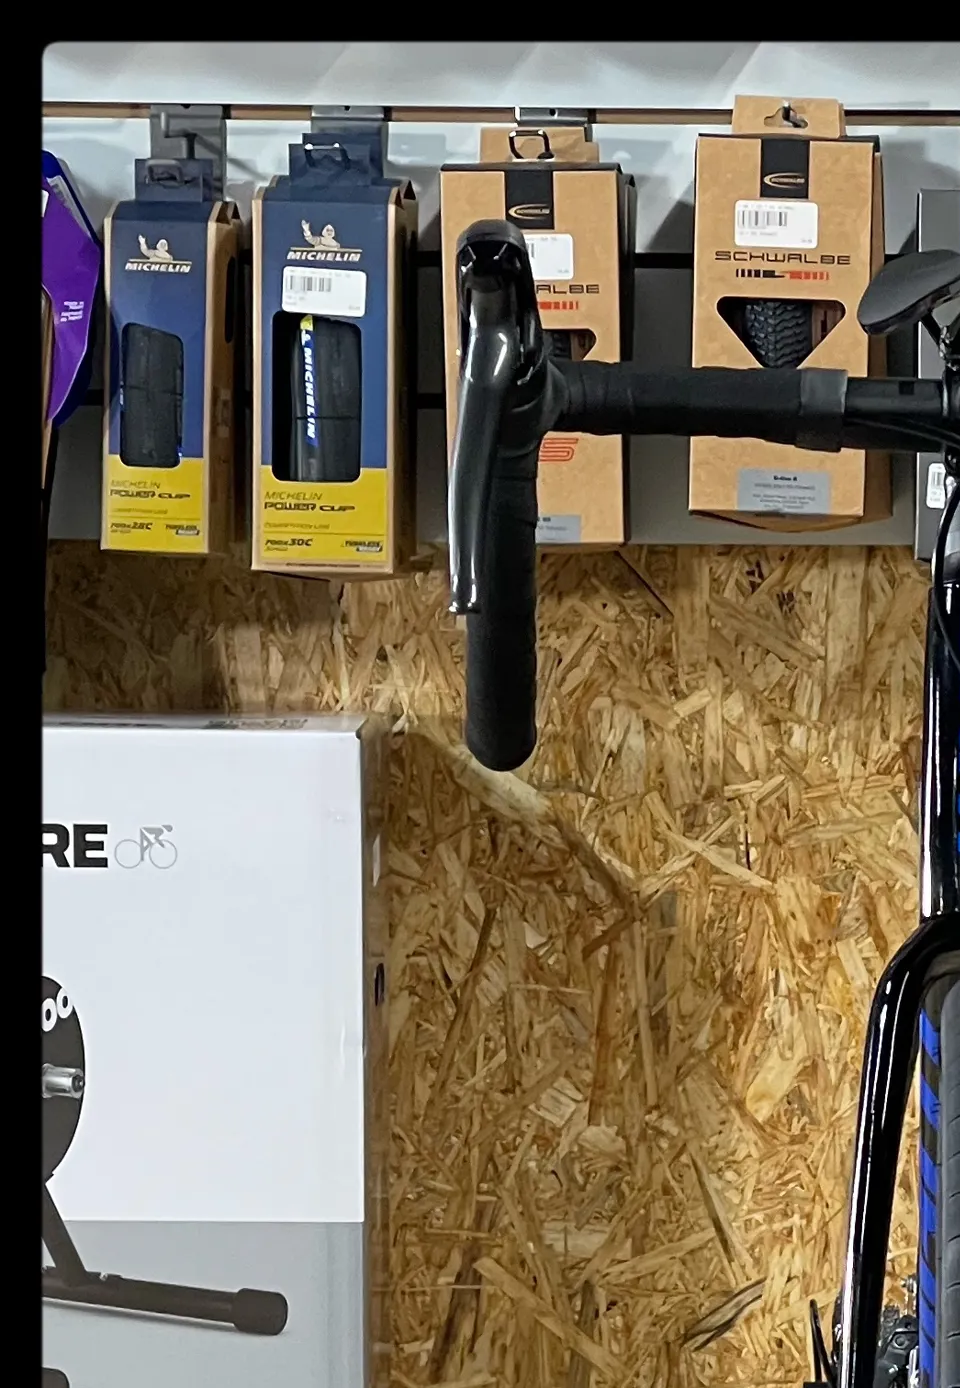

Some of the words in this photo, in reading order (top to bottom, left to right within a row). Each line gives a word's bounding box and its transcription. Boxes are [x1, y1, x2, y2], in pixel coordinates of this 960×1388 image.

[286, 251, 361, 262] MICHELIN
[714, 250, 851, 265] SCHWALBE
[125, 262, 191, 274] MICHELIN
[536, 284, 600, 295] ALBE
[304, 347, 316, 439] MICHELIN
[264, 491, 323, 501] MICHELIN
[264, 501, 317, 512] POWER
[319, 504, 356, 512] CUP
